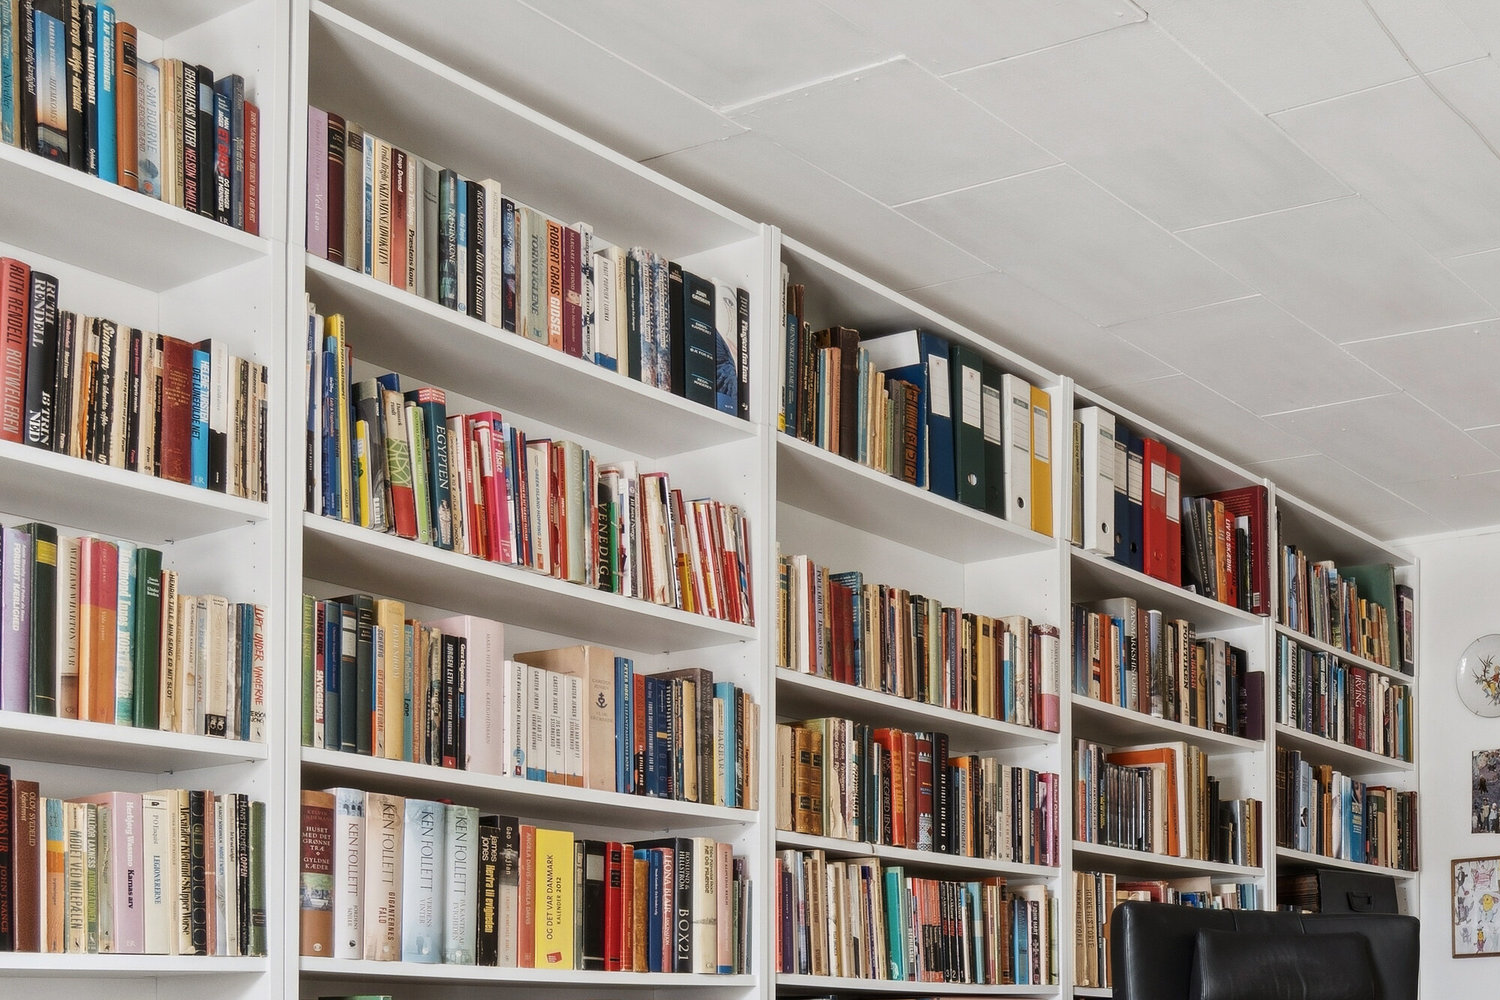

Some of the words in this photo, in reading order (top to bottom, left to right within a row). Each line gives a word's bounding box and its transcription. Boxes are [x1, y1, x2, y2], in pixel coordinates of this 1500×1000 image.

[103, 36, 112, 92] ENSOMHEDEN
[147, 85, 156, 106] SAM
[185, 68, 196, 117] GENERALENS
[147, 108, 157, 152] BOURNE
[185, 118, 196, 147] DATTER
[185, 148, 196, 177] NELSON
[185, 180, 197, 211] DEMILLE
[475, 249, 484, 272] John
[550, 225, 559, 265] ROBERT
[9, 265, 24, 293] RUTH
[476, 275, 484, 315] Grisham
[551, 265, 560, 296] CRAIS
[33, 278, 46, 347] RENDELL
[46, 282, 55, 325] RUTH
[551, 297, 560, 336] GIDSEL
[7, 297, 23, 344] RENDELL
[3, 348, 22, 434] ROTTWEILEREN
[192, 368, 200, 381] DET
[42, 391, 50, 405] 13
[192, 383, 200, 424] LUNEFULDE
[29, 410, 40, 442] NED
[40, 408, 50, 446] TRIN
[191, 426, 200, 440] NET
[437, 425, 448, 489] EGYPTEN
[495, 449, 504, 473] Alsace
[598, 503, 609, 576] VENEDIG
[68, 547, 77, 590] WILLIAM
[12, 583, 21, 631] KÆRLIGHED
[68, 593, 77, 639] WHARTON
[67, 647, 76, 666] FAR
[254, 633, 263, 661] UNDER
[254, 666, 263, 705] VINGERNE
[383, 803, 395, 829] KEN
[421, 811, 433, 836] KEN
[456, 817, 467, 841] KEN
[70, 830, 82, 858] MØDET
[348, 823, 358, 846] KEN
[482, 836, 490, 861] jones
[491, 835, 499, 862] james
[70, 862, 82, 877] VED
[348, 849, 358, 896] FOLLETT
[382, 833, 394, 886] FOLLETT
[420, 840, 433, 892] FOLLETT
[454, 845, 466, 895] FOLLETT
[127, 869, 135, 895] Karnas
[153, 855, 162, 904] LEGIONÆRERNE
[486, 865, 495, 888] Herfra
[71, 880, 83, 929] MILEPÆLEN
[486, 889, 495, 898] til
[378, 907, 387, 923] FALD
[387, 892, 396, 941] GIGANTERNES
[483, 898, 495, 933] evigheden
